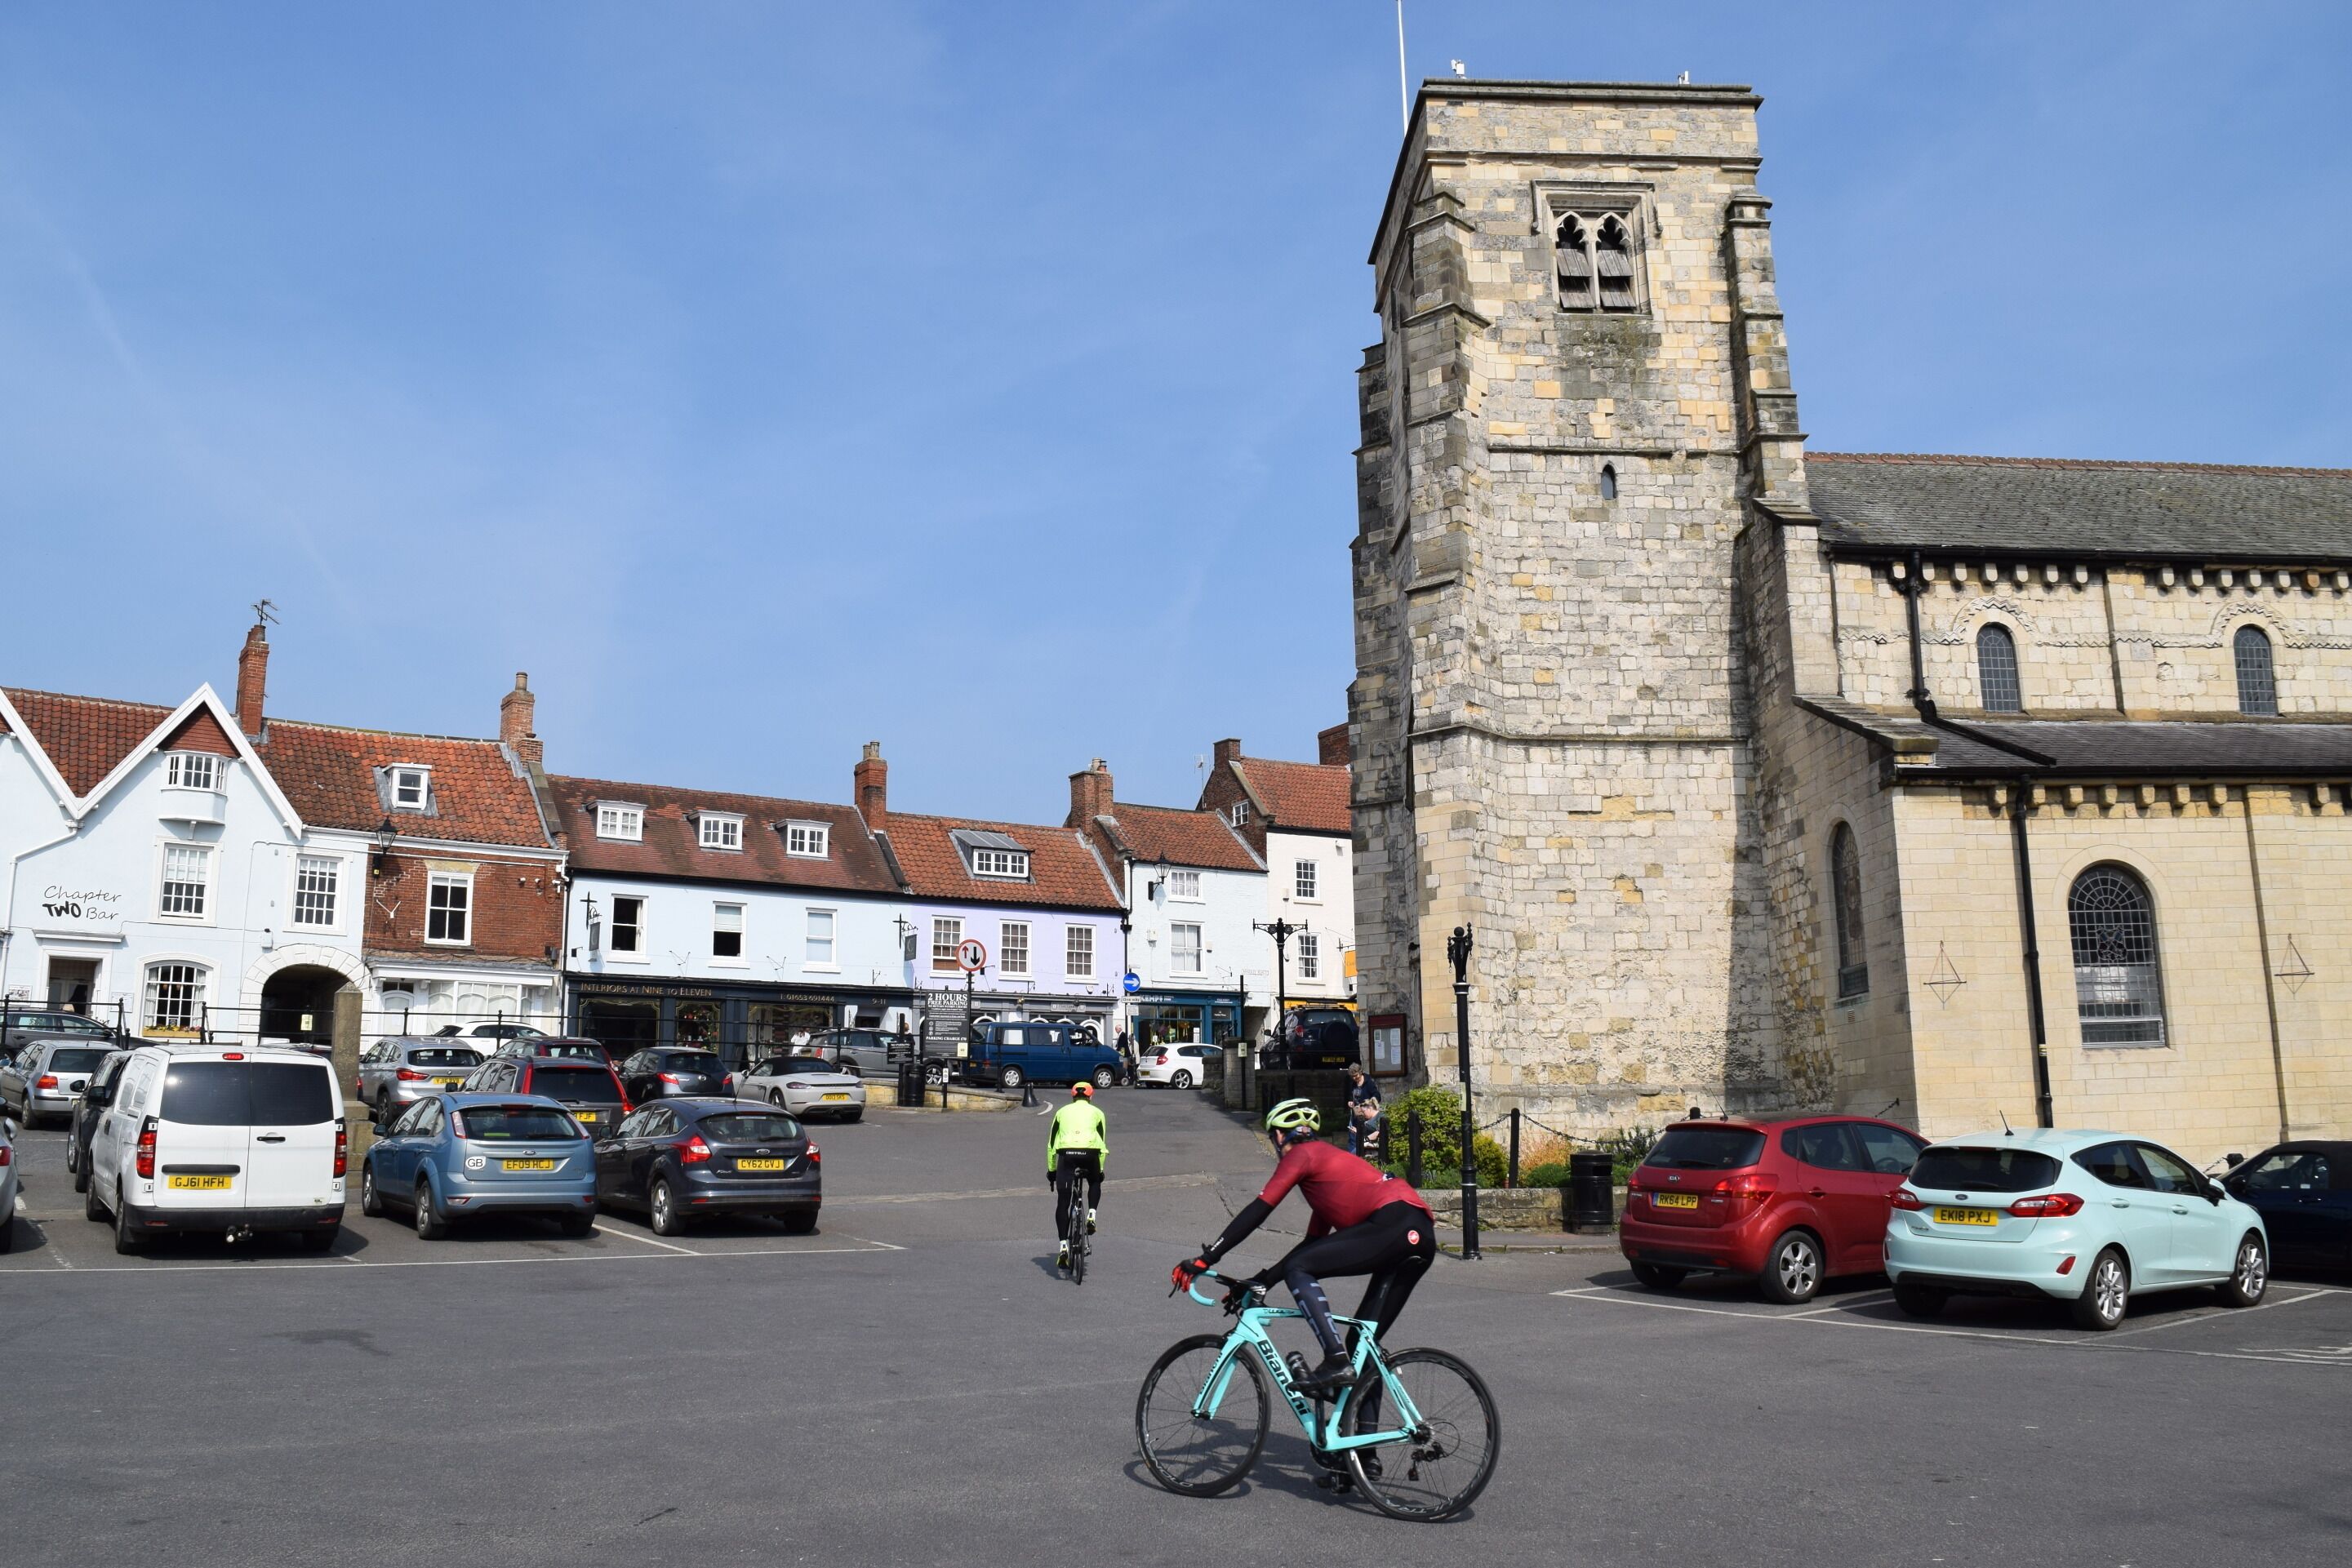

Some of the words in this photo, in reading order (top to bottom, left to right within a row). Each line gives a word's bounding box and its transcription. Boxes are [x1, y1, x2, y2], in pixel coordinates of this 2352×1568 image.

[44, 886, 122, 903] Chapter
[42, 901, 82, 917] TWO
[86, 907, 119, 920] Bar
[580, 982, 628, 993] INTERIORS
[642, 985, 664, 995] NINE
[667, 988, 678, 996] TO
[680, 988, 712, 997] ELEVEN
[928, 993, 933, 1001] 2
[935, 993, 967, 1002] HOURS
[467, 1158, 483, 1167] GB
[506, 1160, 531, 1169] EF09
[740, 1160, 763, 1168] CY62
[764, 1160, 780, 1169] GVJ
[175, 1177, 200, 1187] GJ61
[202, 1177, 225, 1188] HFH
[1659, 1194, 1679, 1206] RK64
[1681, 1196, 1696, 1206] LPP
[1940, 1210, 1965, 1222] EK18
[1967, 1210, 1991, 1224] PXJ
